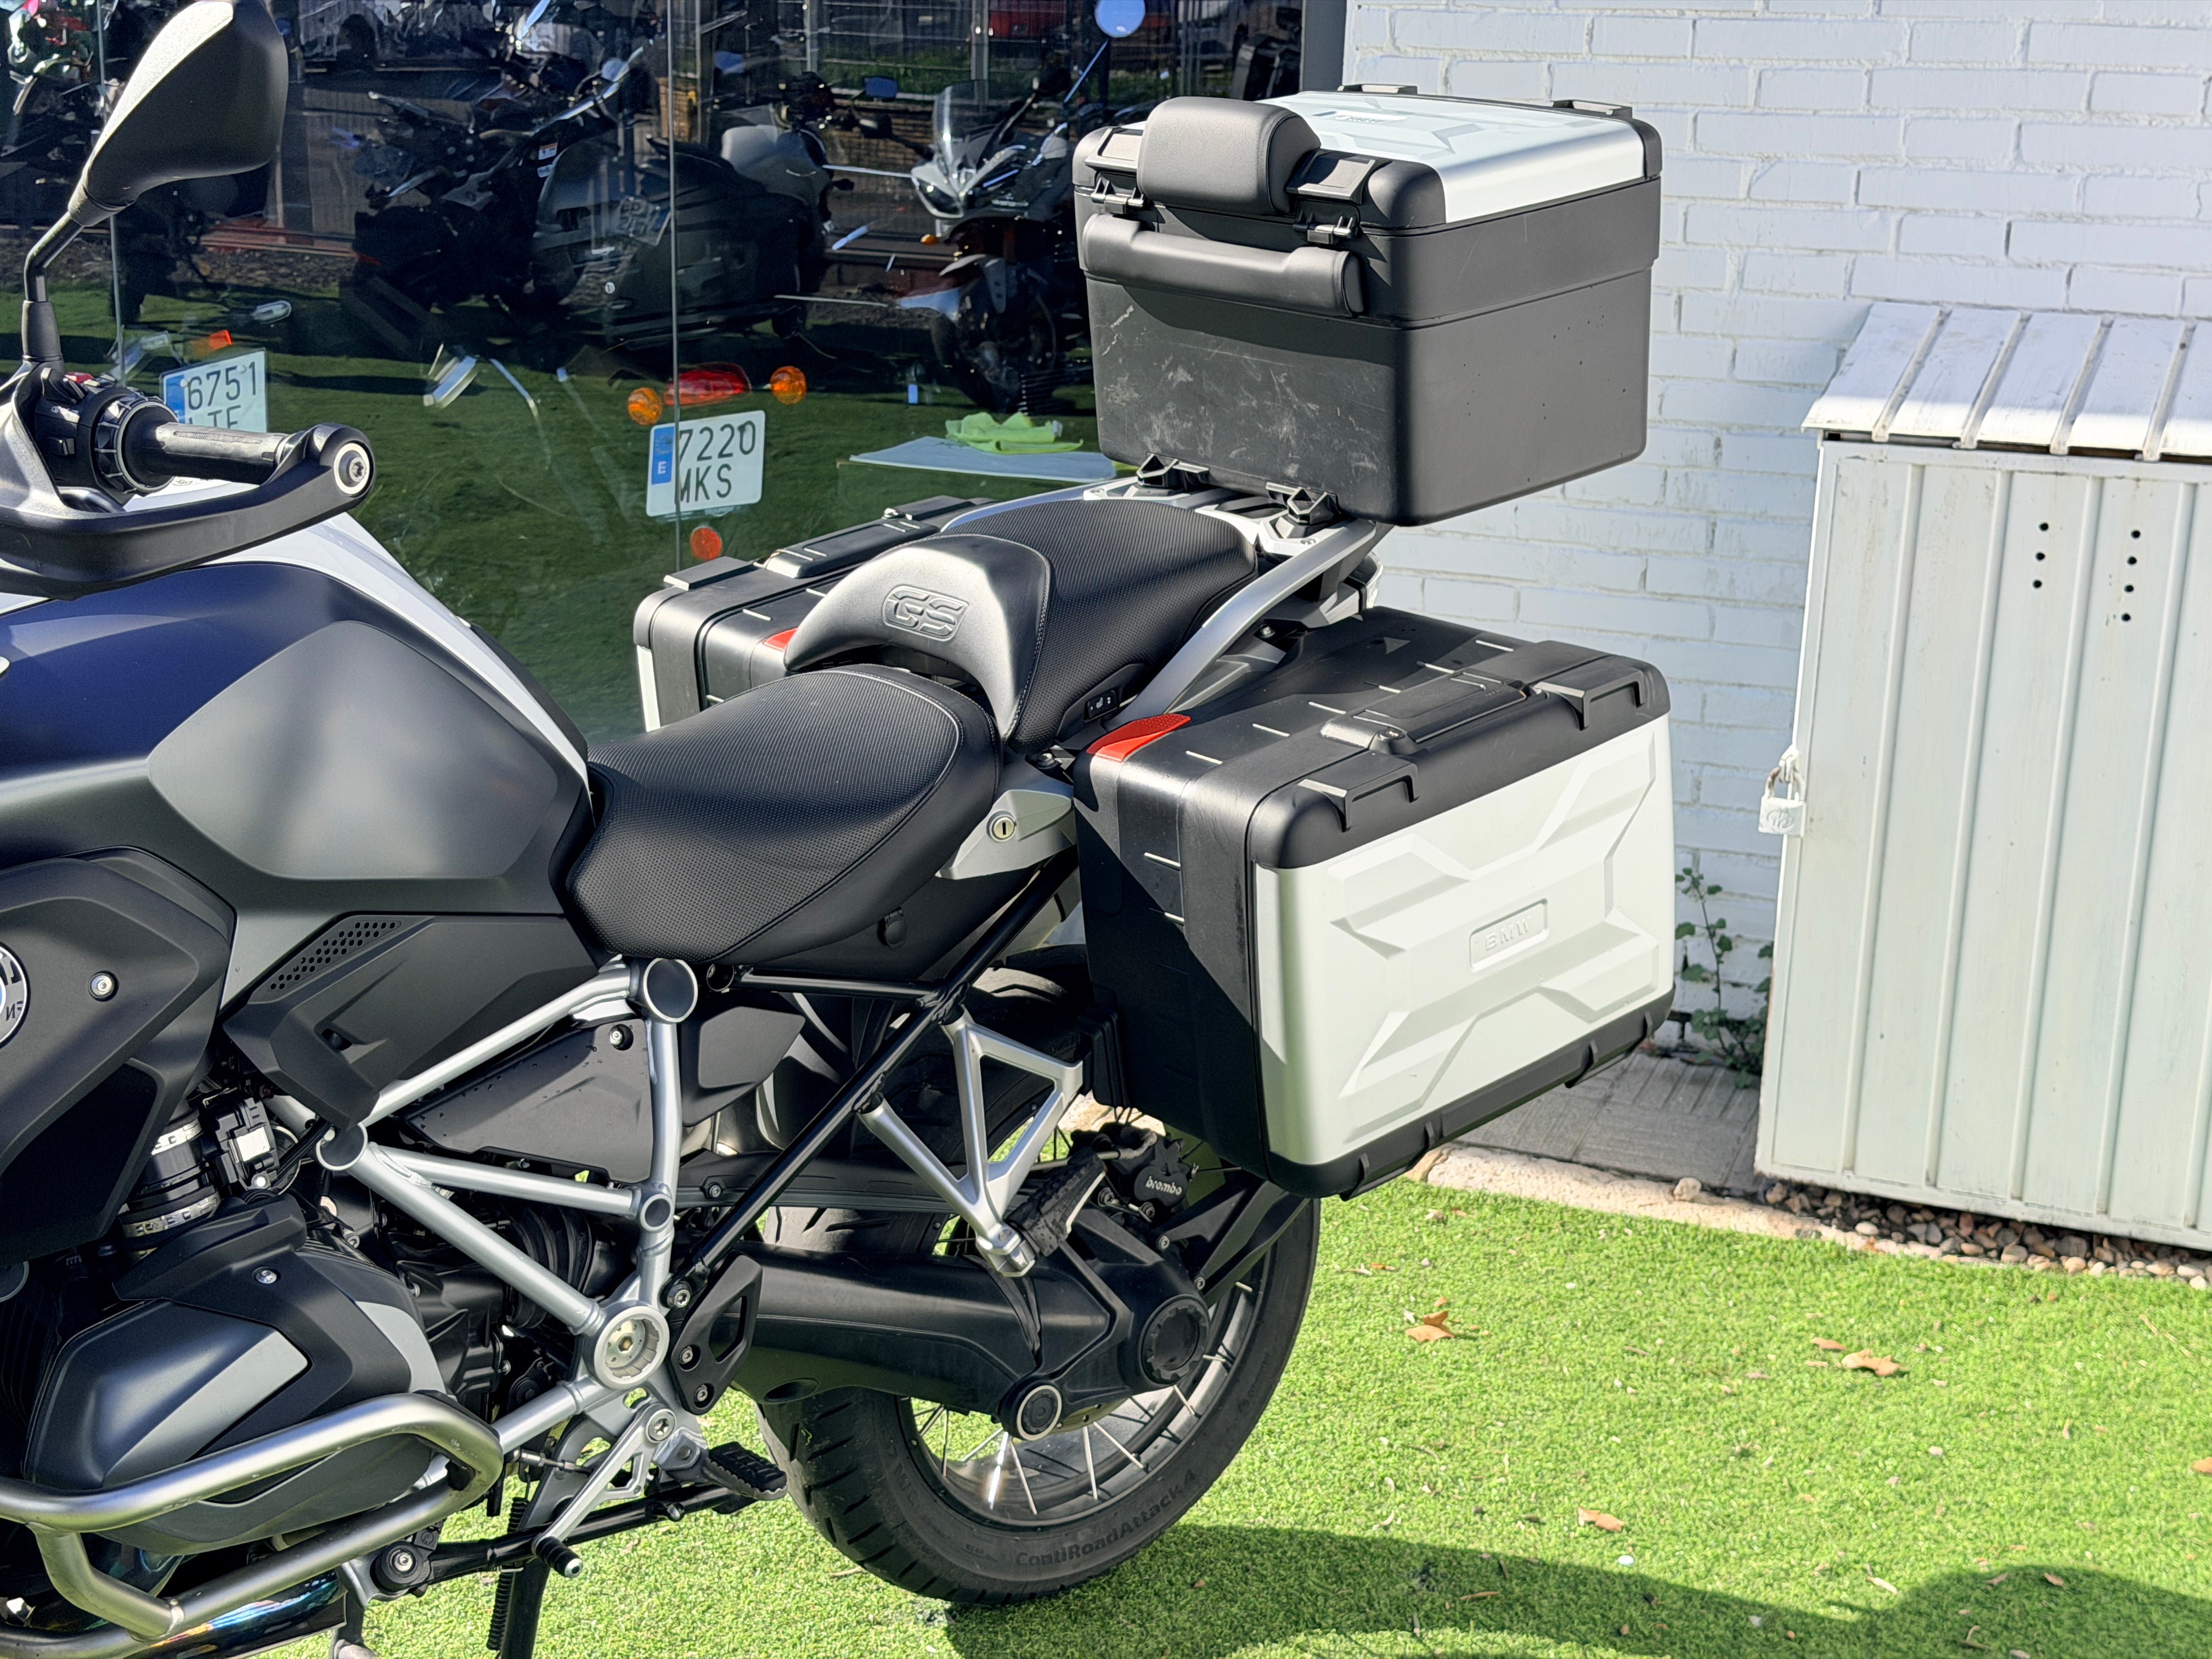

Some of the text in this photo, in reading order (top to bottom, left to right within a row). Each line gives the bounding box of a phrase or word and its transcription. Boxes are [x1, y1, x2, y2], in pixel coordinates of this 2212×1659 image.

[188, 362, 256, 410] 6751
[679, 420, 756, 462] 7220
[657, 460, 667, 475] E
[884, 589, 964, 637] GS
[1145, 1175, 1182, 1195] brembo
